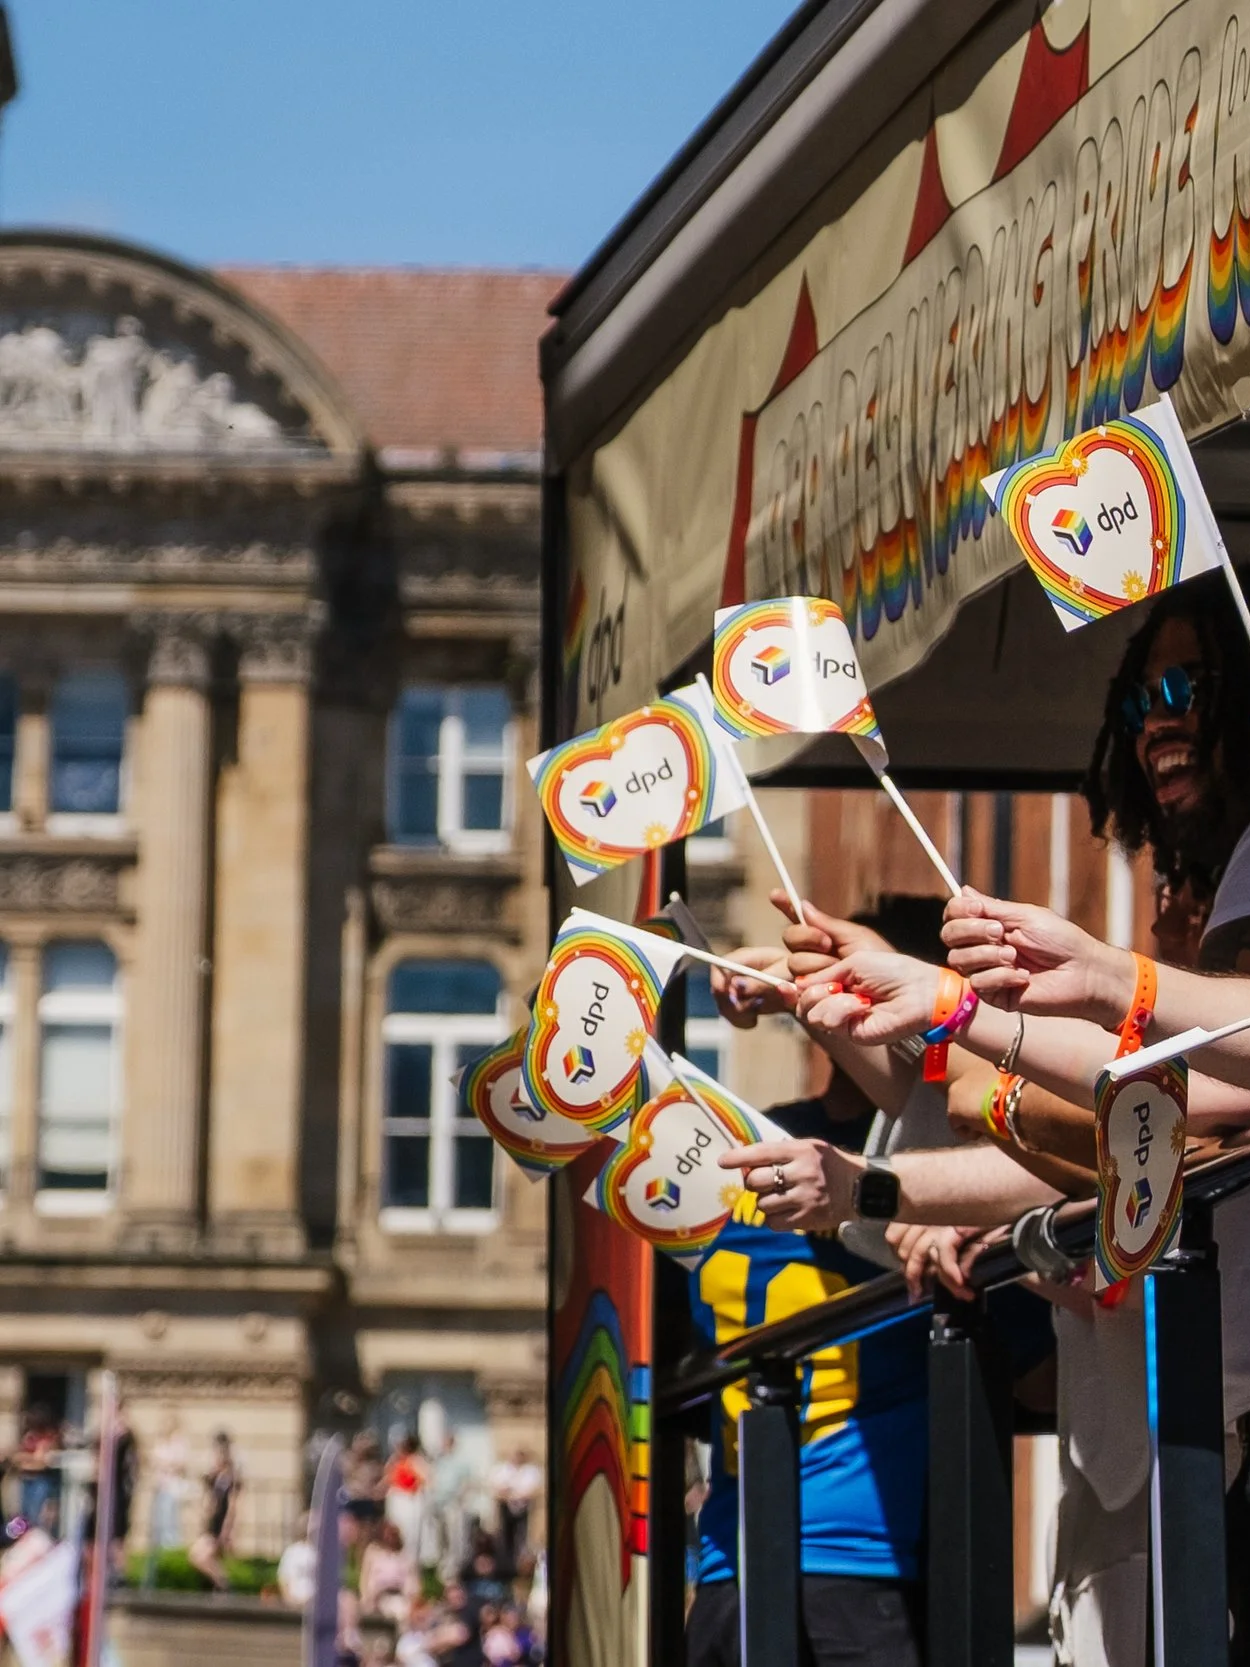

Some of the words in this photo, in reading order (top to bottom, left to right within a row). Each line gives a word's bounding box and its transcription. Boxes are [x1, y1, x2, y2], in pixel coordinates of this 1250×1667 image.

[832, 180, 1058, 590] DELIVERING
[1066, 46, 1200, 378] PRIDE
[1096, 490, 1140, 535] dpd
[588, 562, 628, 728] dpd
[625, 756, 673, 794] dpd
[580, 980, 610, 1036] dpd
[675, 1127, 712, 1175] dpd
[1132, 1101, 1154, 1167] dpd
